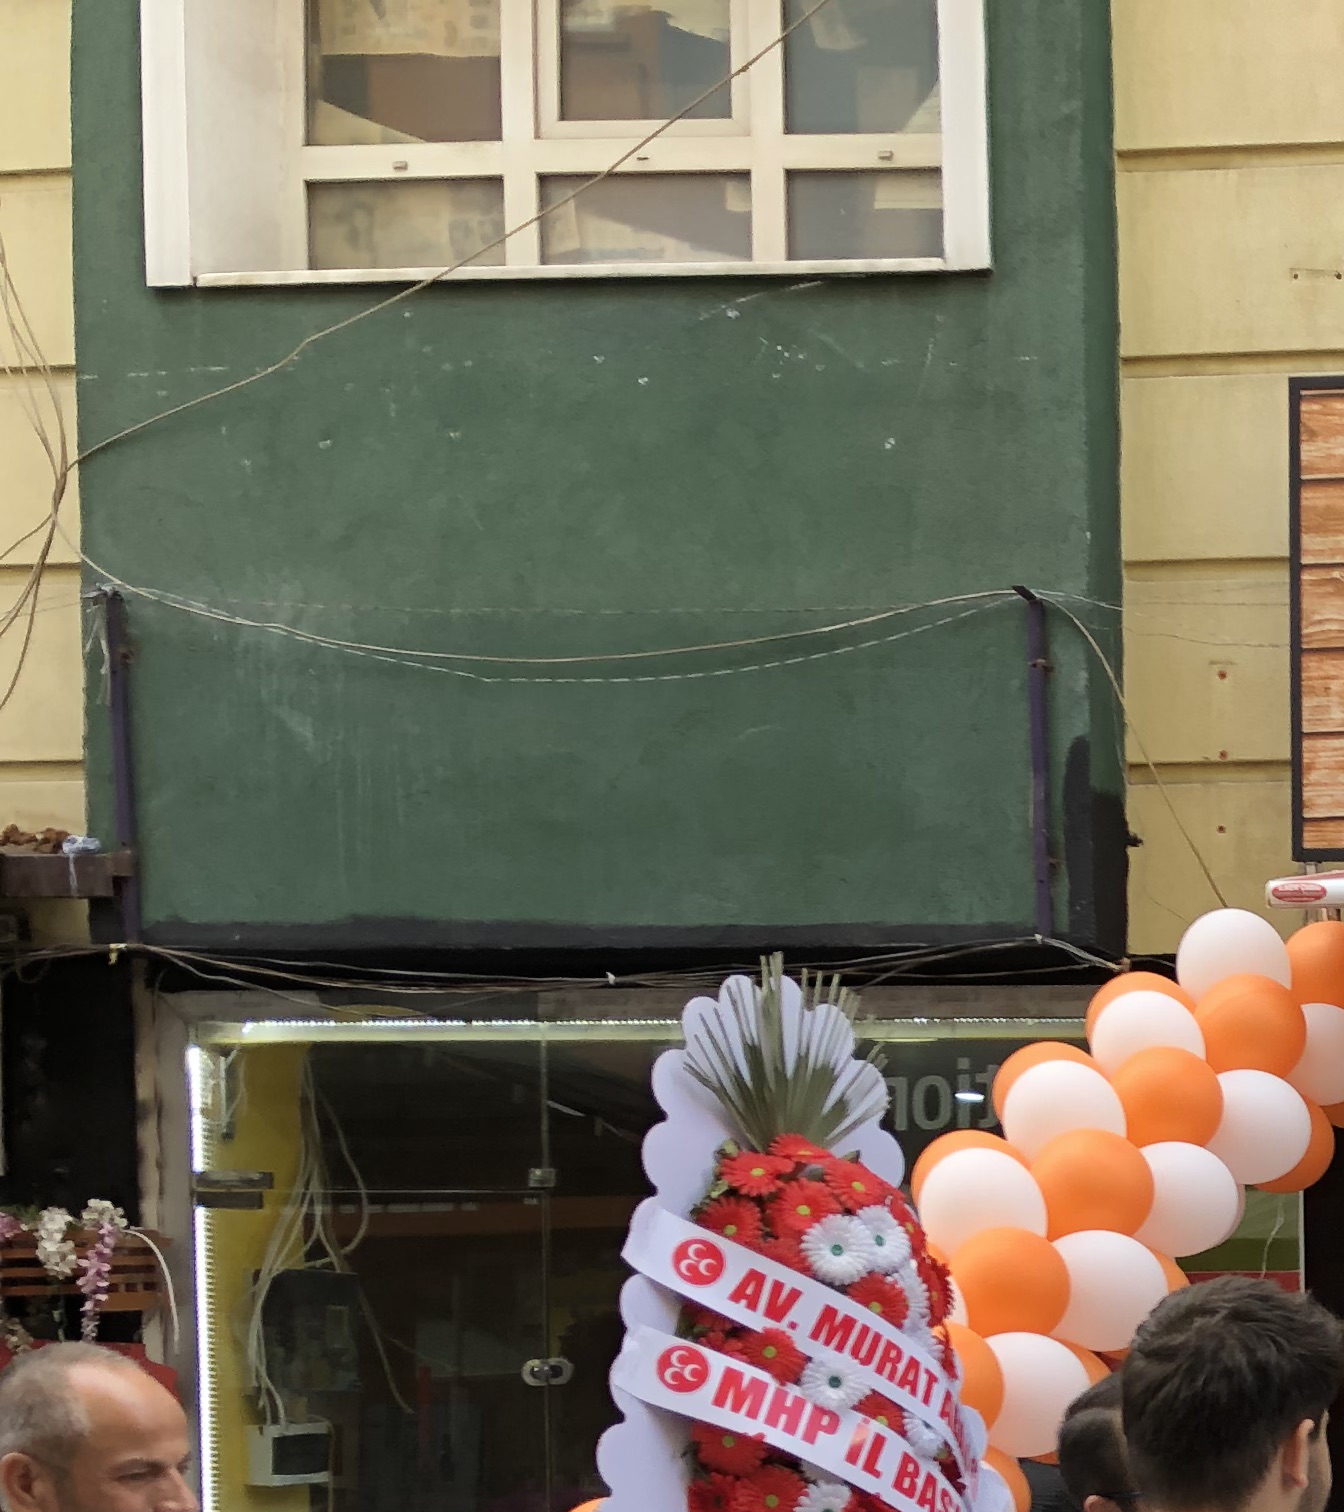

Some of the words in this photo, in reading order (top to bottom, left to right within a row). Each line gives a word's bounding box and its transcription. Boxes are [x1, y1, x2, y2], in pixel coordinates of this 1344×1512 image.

[728, 1267, 803, 1331] AV.
[808, 1303, 940, 1408] MURAT
[711, 1365, 842, 1446] MHP
[843, 1418, 889, 1480] İL
